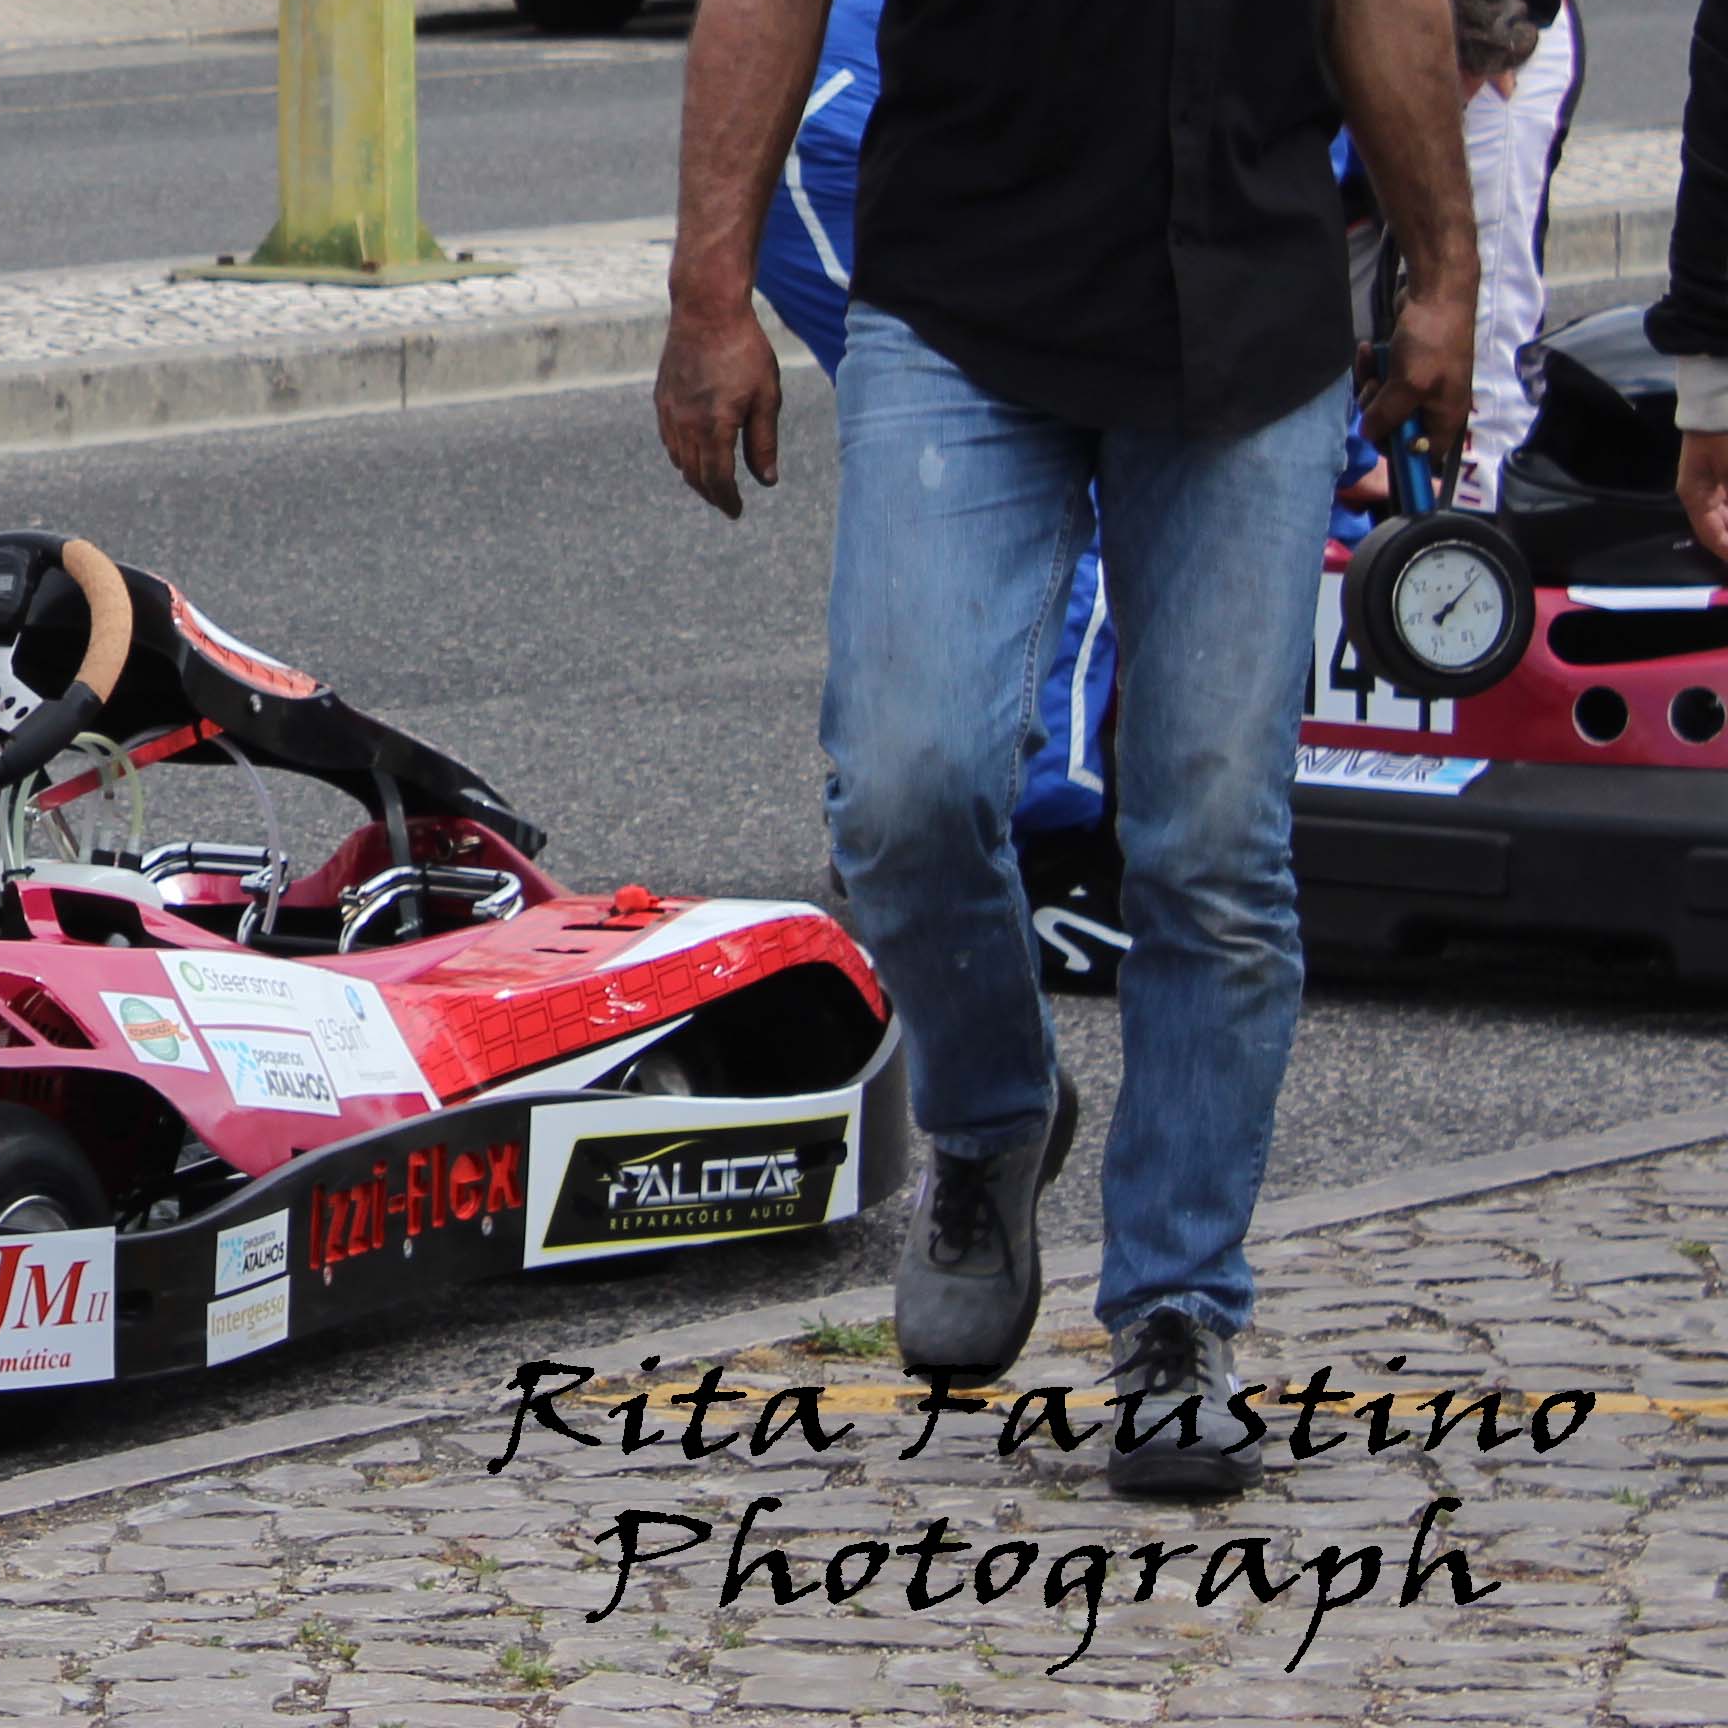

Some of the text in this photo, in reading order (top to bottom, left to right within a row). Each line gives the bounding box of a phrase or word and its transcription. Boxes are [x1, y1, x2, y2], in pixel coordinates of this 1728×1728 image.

[202, 966, 295, 1001] Steersman
[252, 1047, 305, 1069] pequenos
[265, 1069, 331, 1103] ATALHOS
[310, 1141, 523, 1270] Izzi-Flex
[609, 1202, 796, 1231] REPARAÇÕES AUTO
[243, 1229, 277, 1251] pequenos
[243, 1240, 285, 1275] ATALHOS
[211, 1293, 285, 1337] Intergesso
